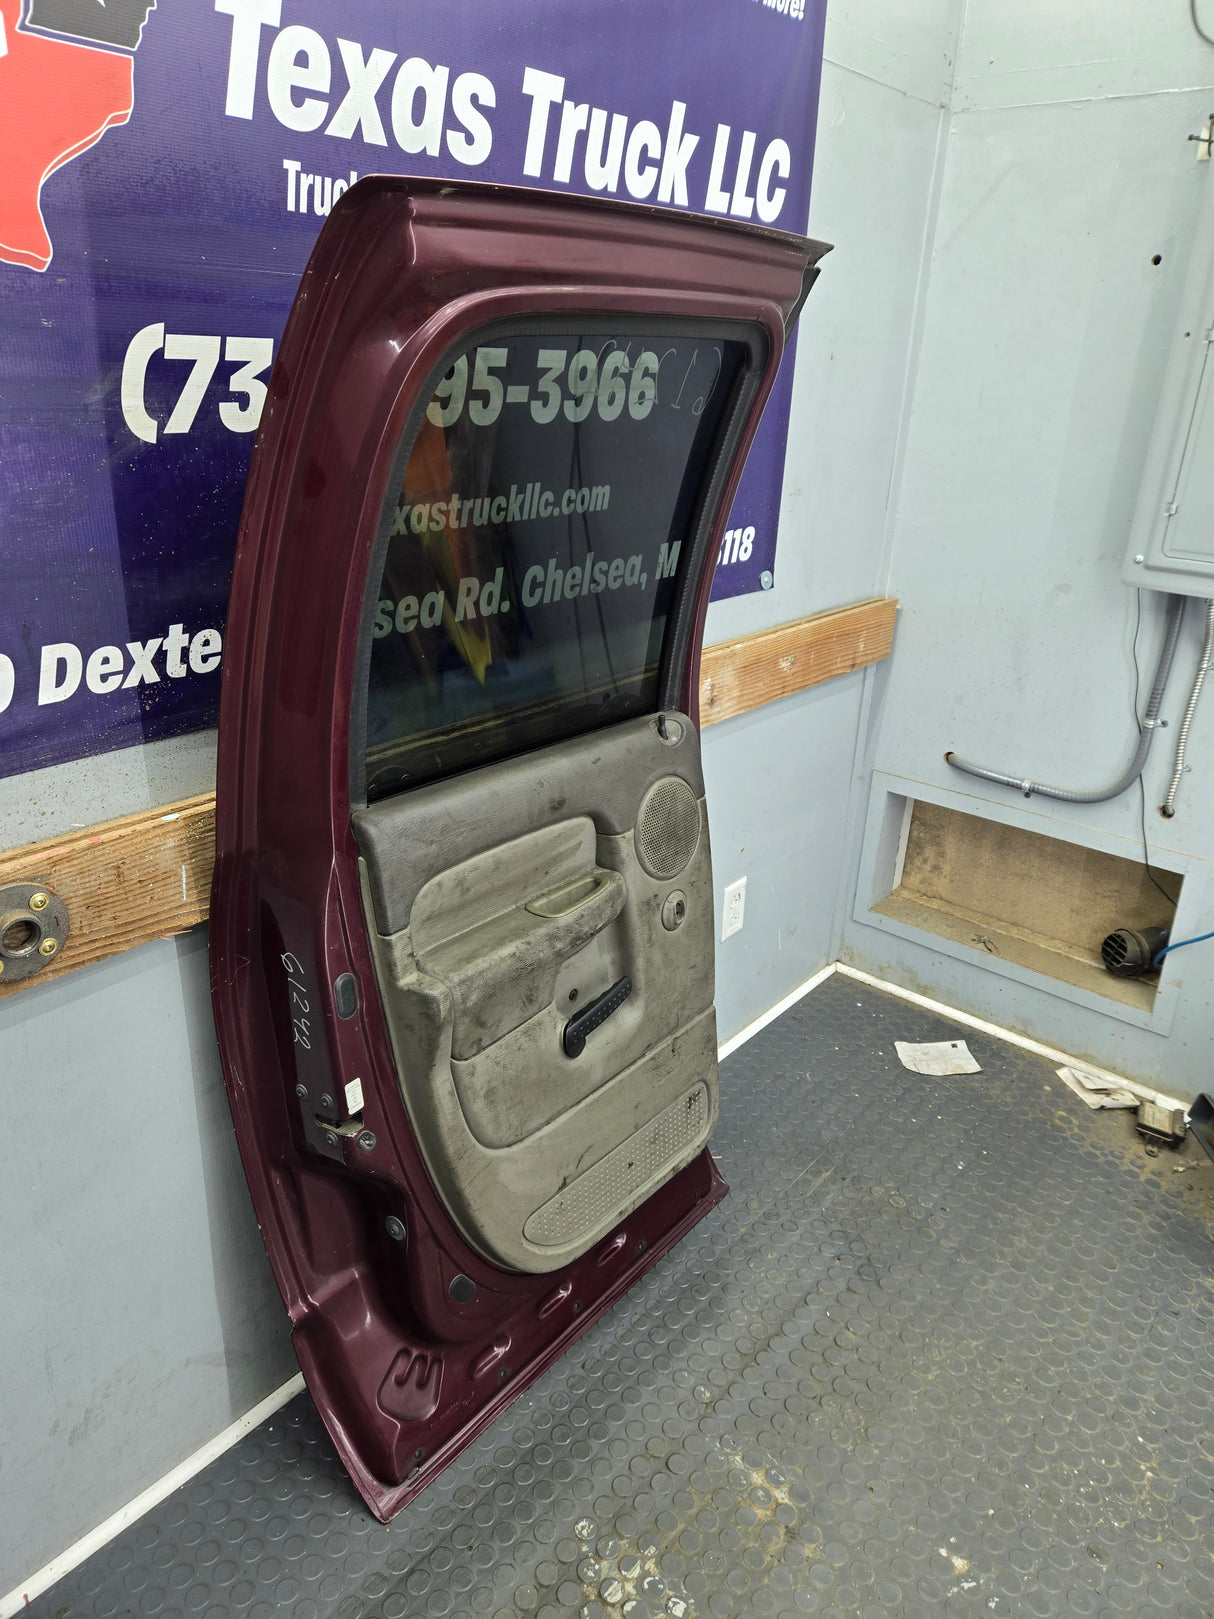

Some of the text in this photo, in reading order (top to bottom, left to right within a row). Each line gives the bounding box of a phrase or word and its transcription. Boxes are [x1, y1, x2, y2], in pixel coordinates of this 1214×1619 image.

[215, 0, 791, 223] Texas Truck LLC
[121, 323, 659, 443] (73 95-3966
[390, 482, 611, 537] xastruckllc.com
[38, 623, 222, 706] Dexte
[373, 591, 445, 639] sea
[455, 567, 510, 623] Rd.
[521, 552, 648, 608] Chelsea,
[655, 540, 682, 580] M
[717, 526, 756, 566] 118
[280, 952, 311, 1050] 61242
